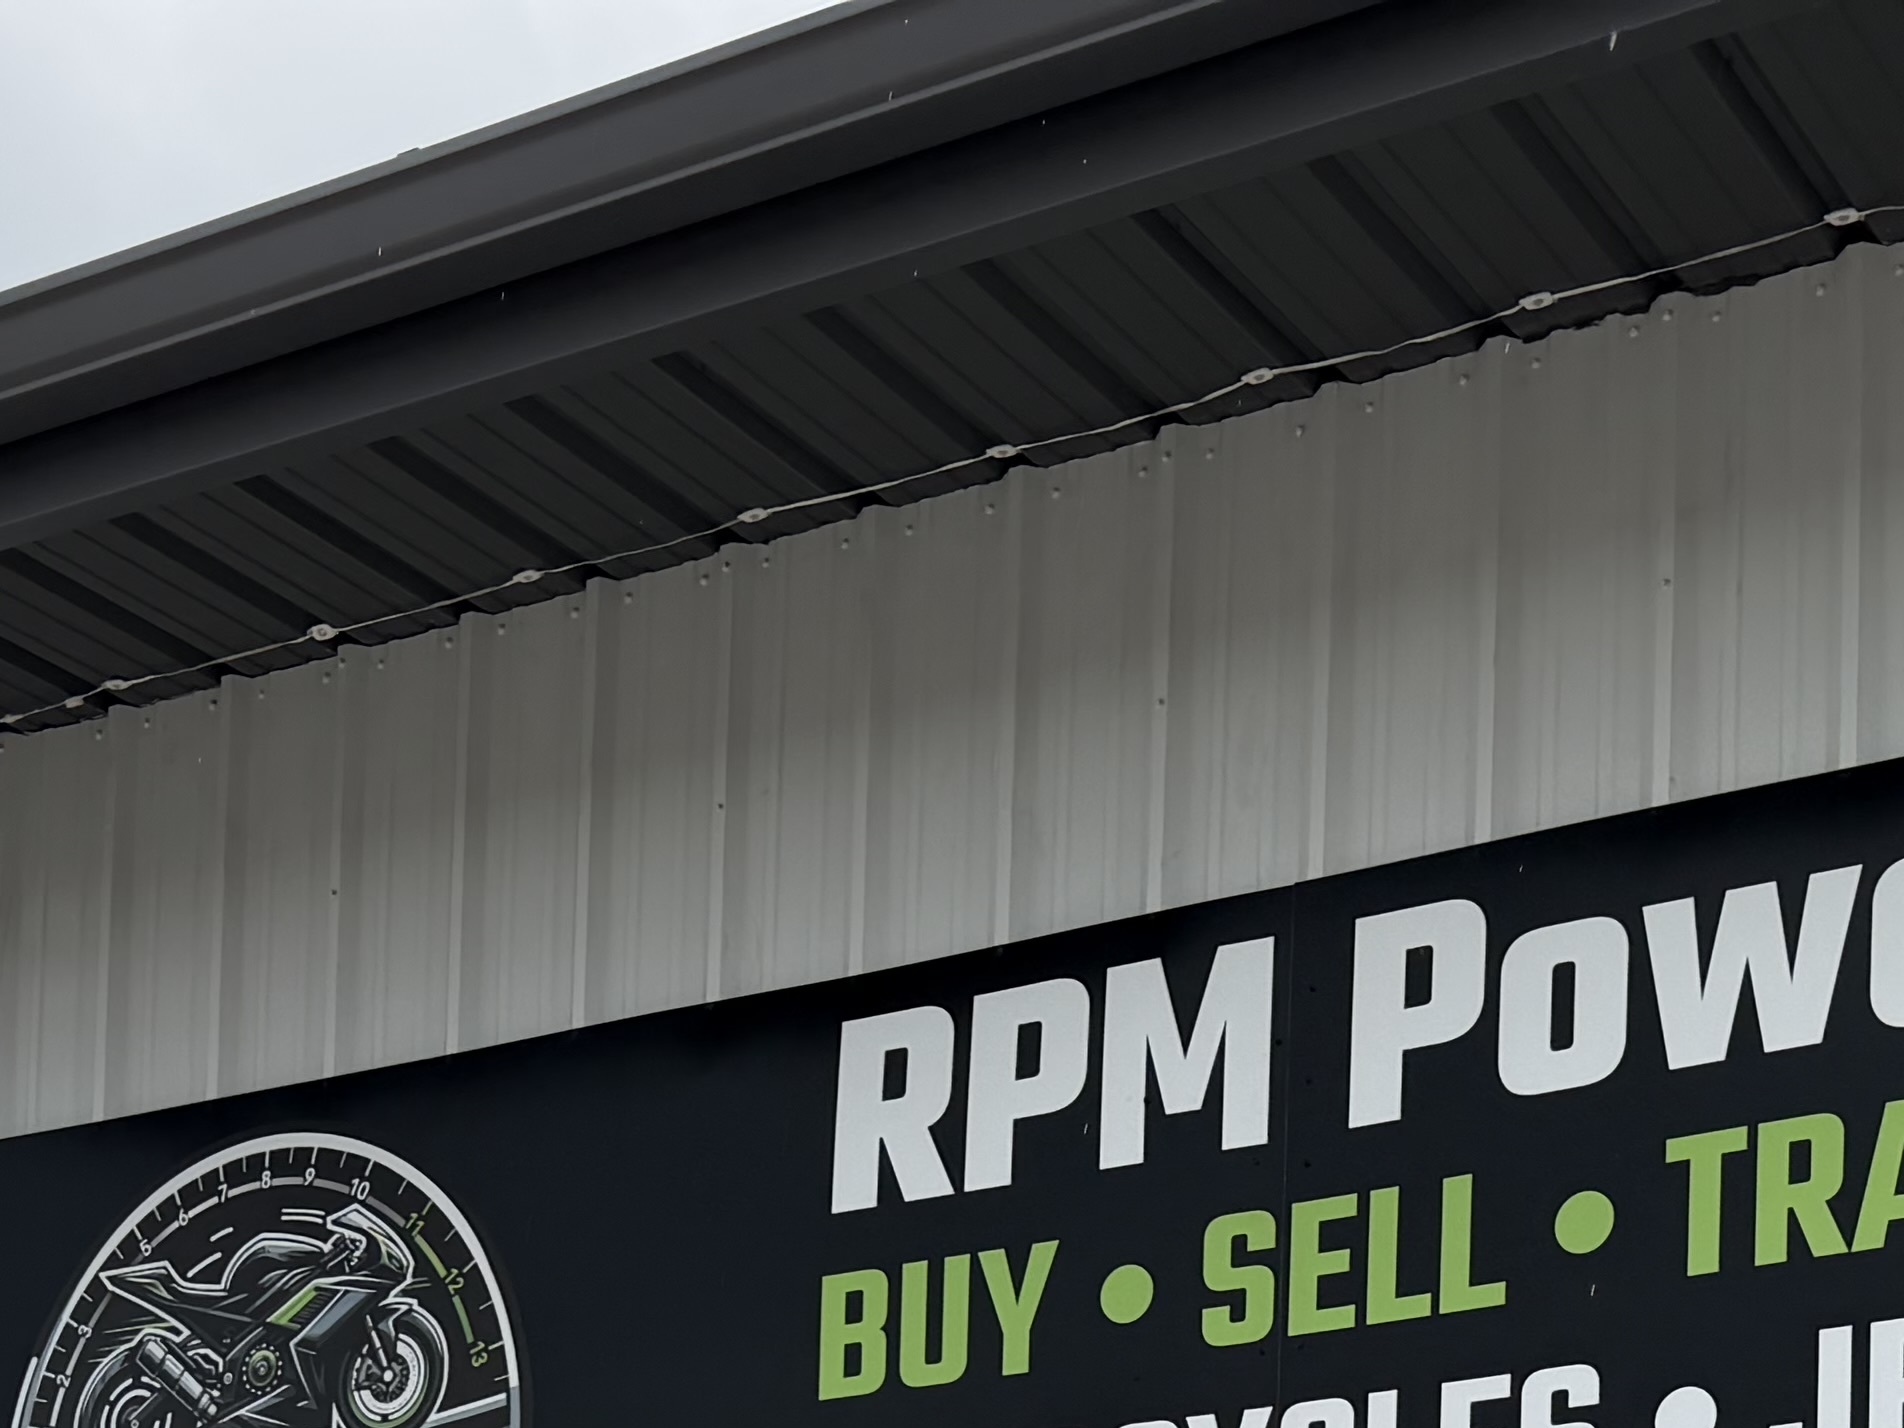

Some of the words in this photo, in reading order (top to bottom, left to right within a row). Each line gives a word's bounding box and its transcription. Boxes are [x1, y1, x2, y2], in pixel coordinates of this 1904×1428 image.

[832, 936, 1274, 1214] RPM
[349, 1178, 371, 1200] 10
[819, 1240, 1059, 1400] BUY
[1202, 1174, 1506, 1346] SELL
